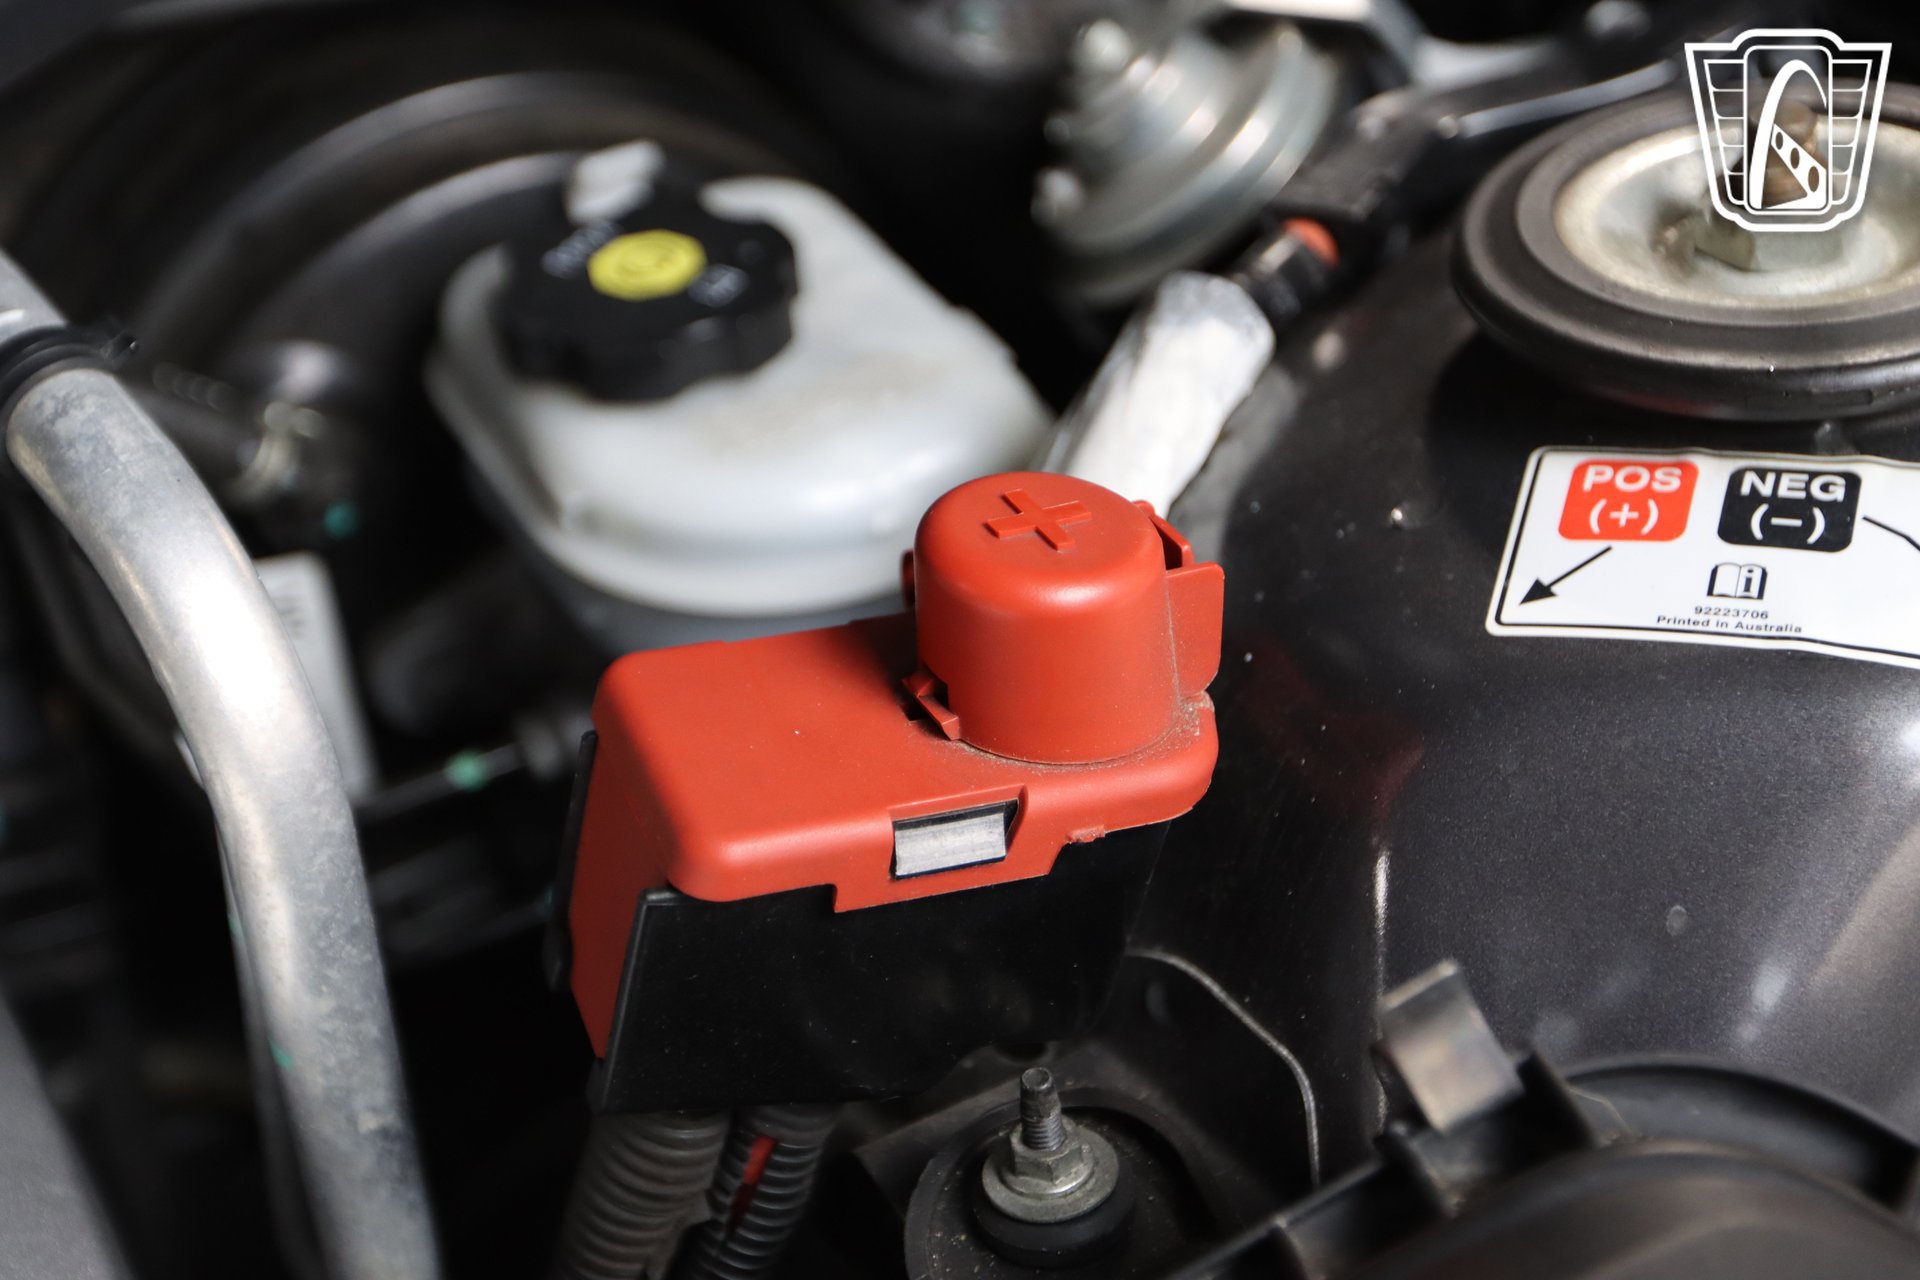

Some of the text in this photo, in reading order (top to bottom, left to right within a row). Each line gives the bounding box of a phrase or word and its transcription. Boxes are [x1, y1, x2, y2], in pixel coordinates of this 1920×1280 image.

[1583, 465, 1682, 493] POS
[1740, 471, 1846, 502] NEG
[1589, 499, 1660, 536] (+)
[1656, 615, 1803, 634] Printed in Australia
[1694, 606, 1769, 620] 92223706
